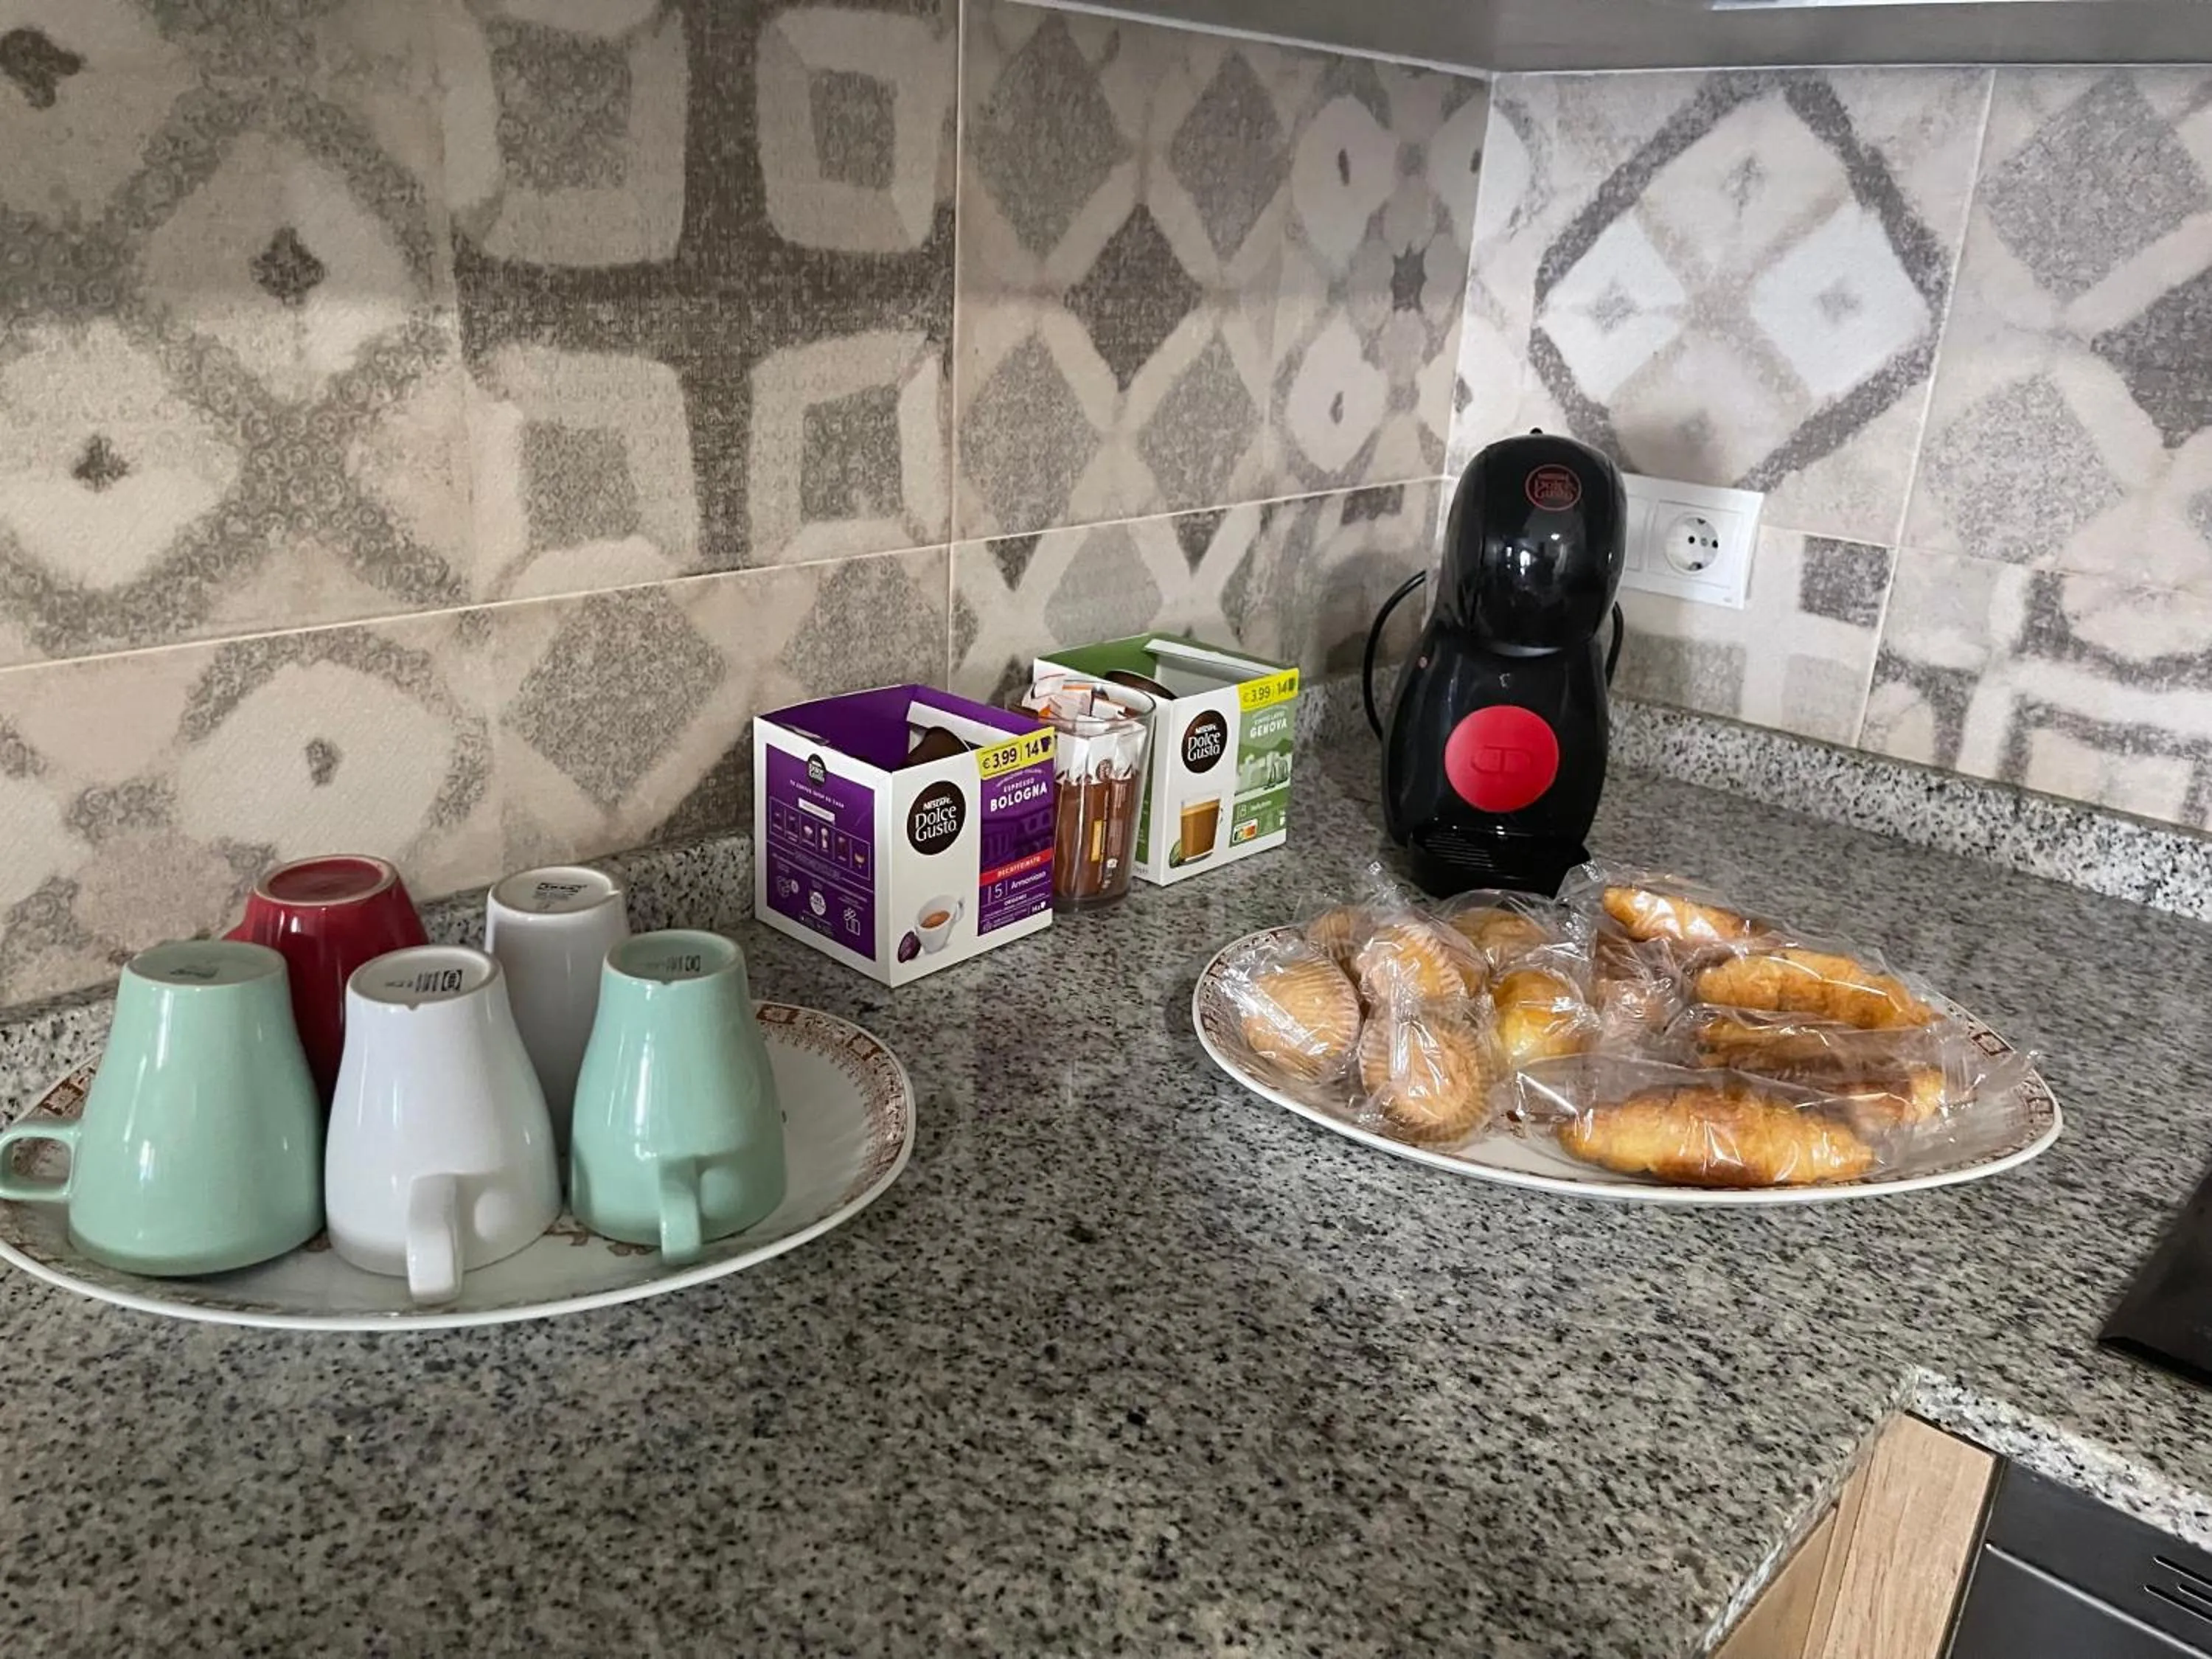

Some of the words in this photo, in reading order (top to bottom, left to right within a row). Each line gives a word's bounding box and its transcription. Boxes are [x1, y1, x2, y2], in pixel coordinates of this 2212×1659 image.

[1250, 717, 1287, 739] GENOVA
[1188, 732, 1221, 750] Dolce
[983, 757, 991, 769] €
[1024, 740, 1039, 758] 14
[1188, 744, 1220, 762] Gusto
[990, 782, 1048, 813] BOLOGNA
[915, 806, 957, 830] Dolce
[915, 819, 958, 842] Gusto
[994, 883, 1003, 899] 5
